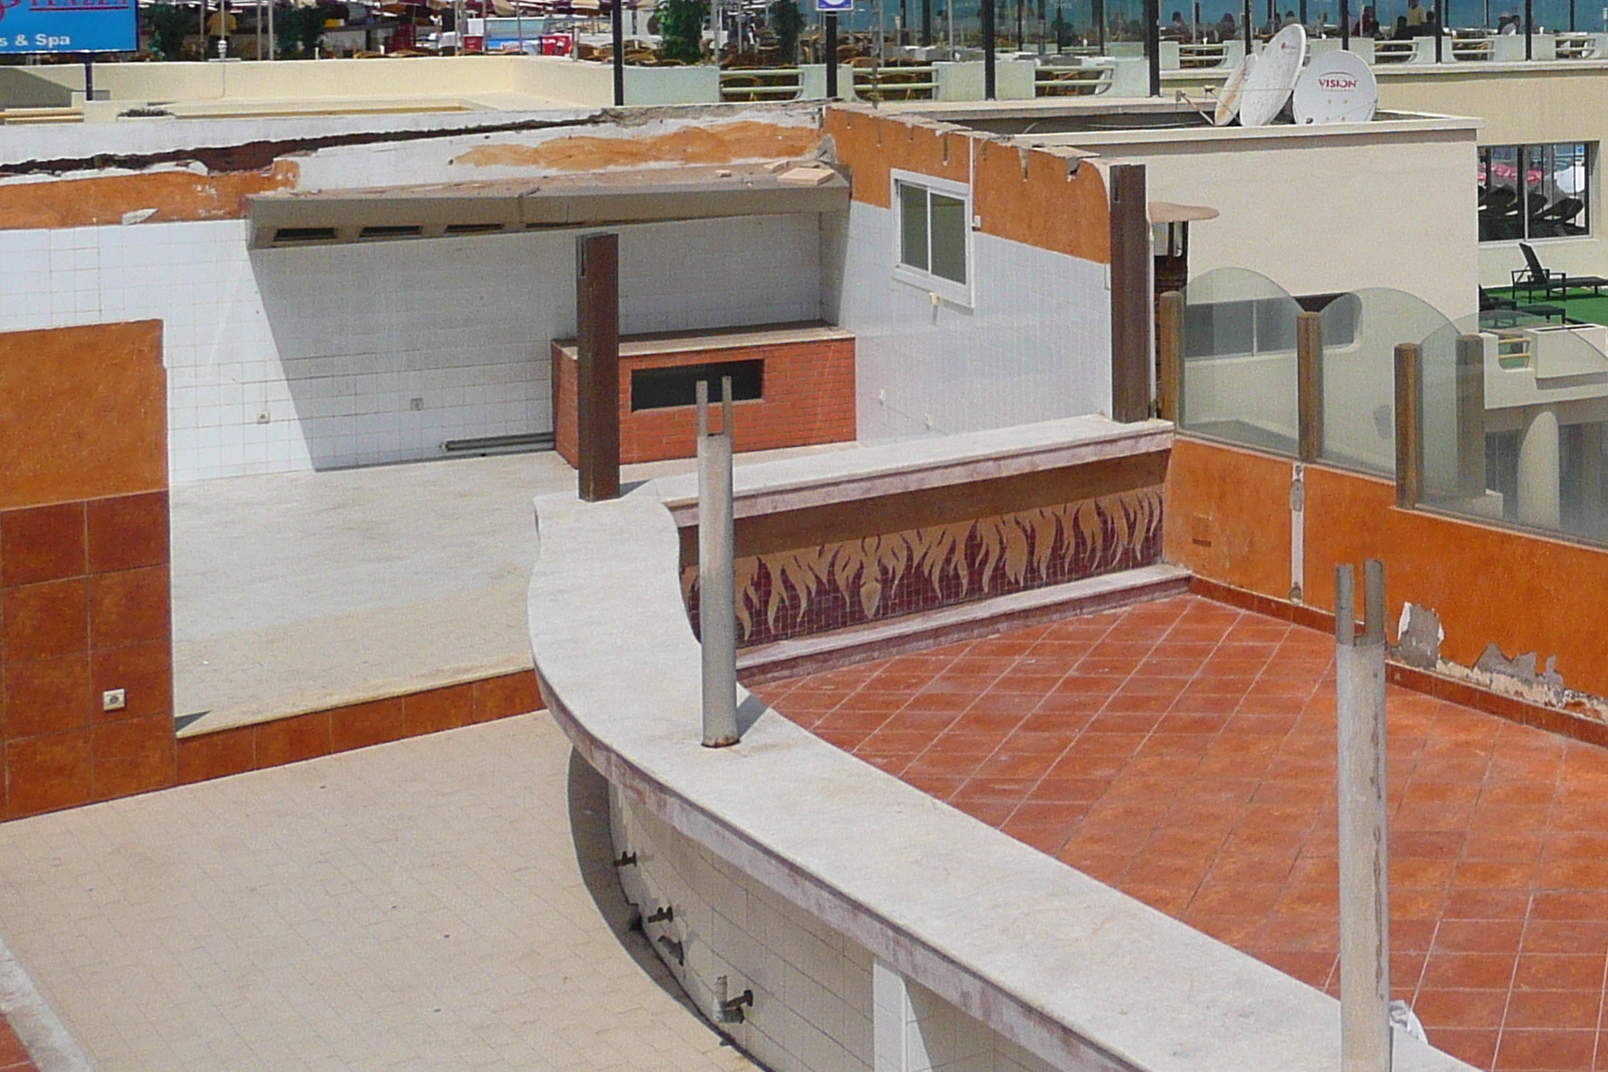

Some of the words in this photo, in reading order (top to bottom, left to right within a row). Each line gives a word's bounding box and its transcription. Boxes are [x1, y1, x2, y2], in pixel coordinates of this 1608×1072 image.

[15, 33, 29, 46] &
[35, 33, 70, 48] Spa
[1317, 78, 1358, 88] VISION
